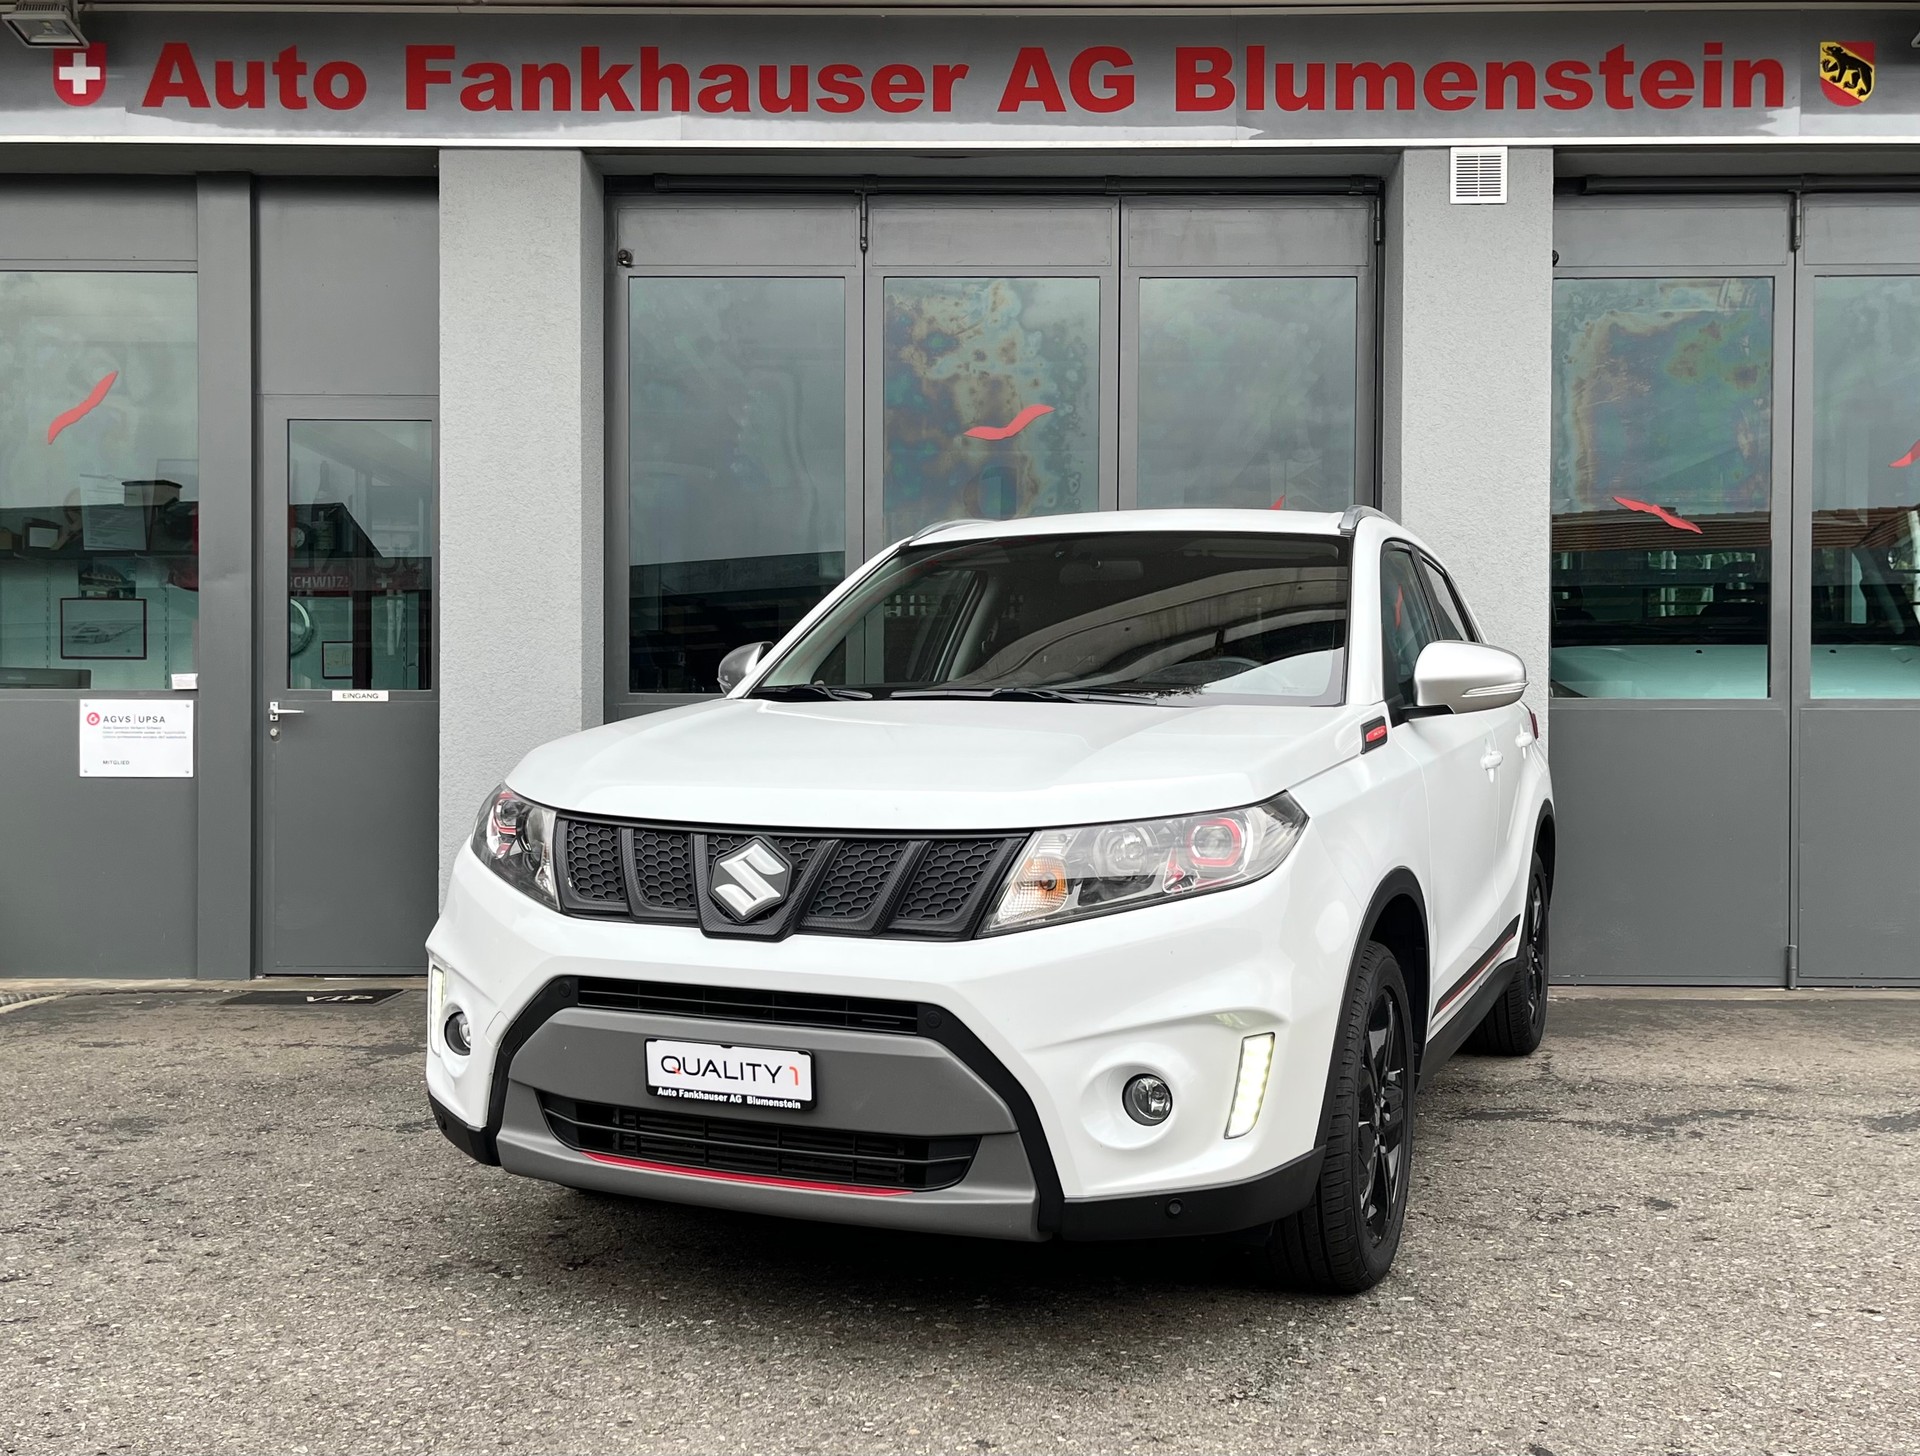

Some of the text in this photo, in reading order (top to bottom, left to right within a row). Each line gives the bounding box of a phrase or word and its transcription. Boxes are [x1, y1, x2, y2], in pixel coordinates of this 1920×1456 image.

[143, 42, 1785, 114] Auto Fankhauser AG Blumenstein
[103, 715, 166, 723] AGVS UPSA
[661, 1055, 782, 1084] QUALITY
[657, 1087, 801, 1110] Auto Fankhauser AG Blumenstein
